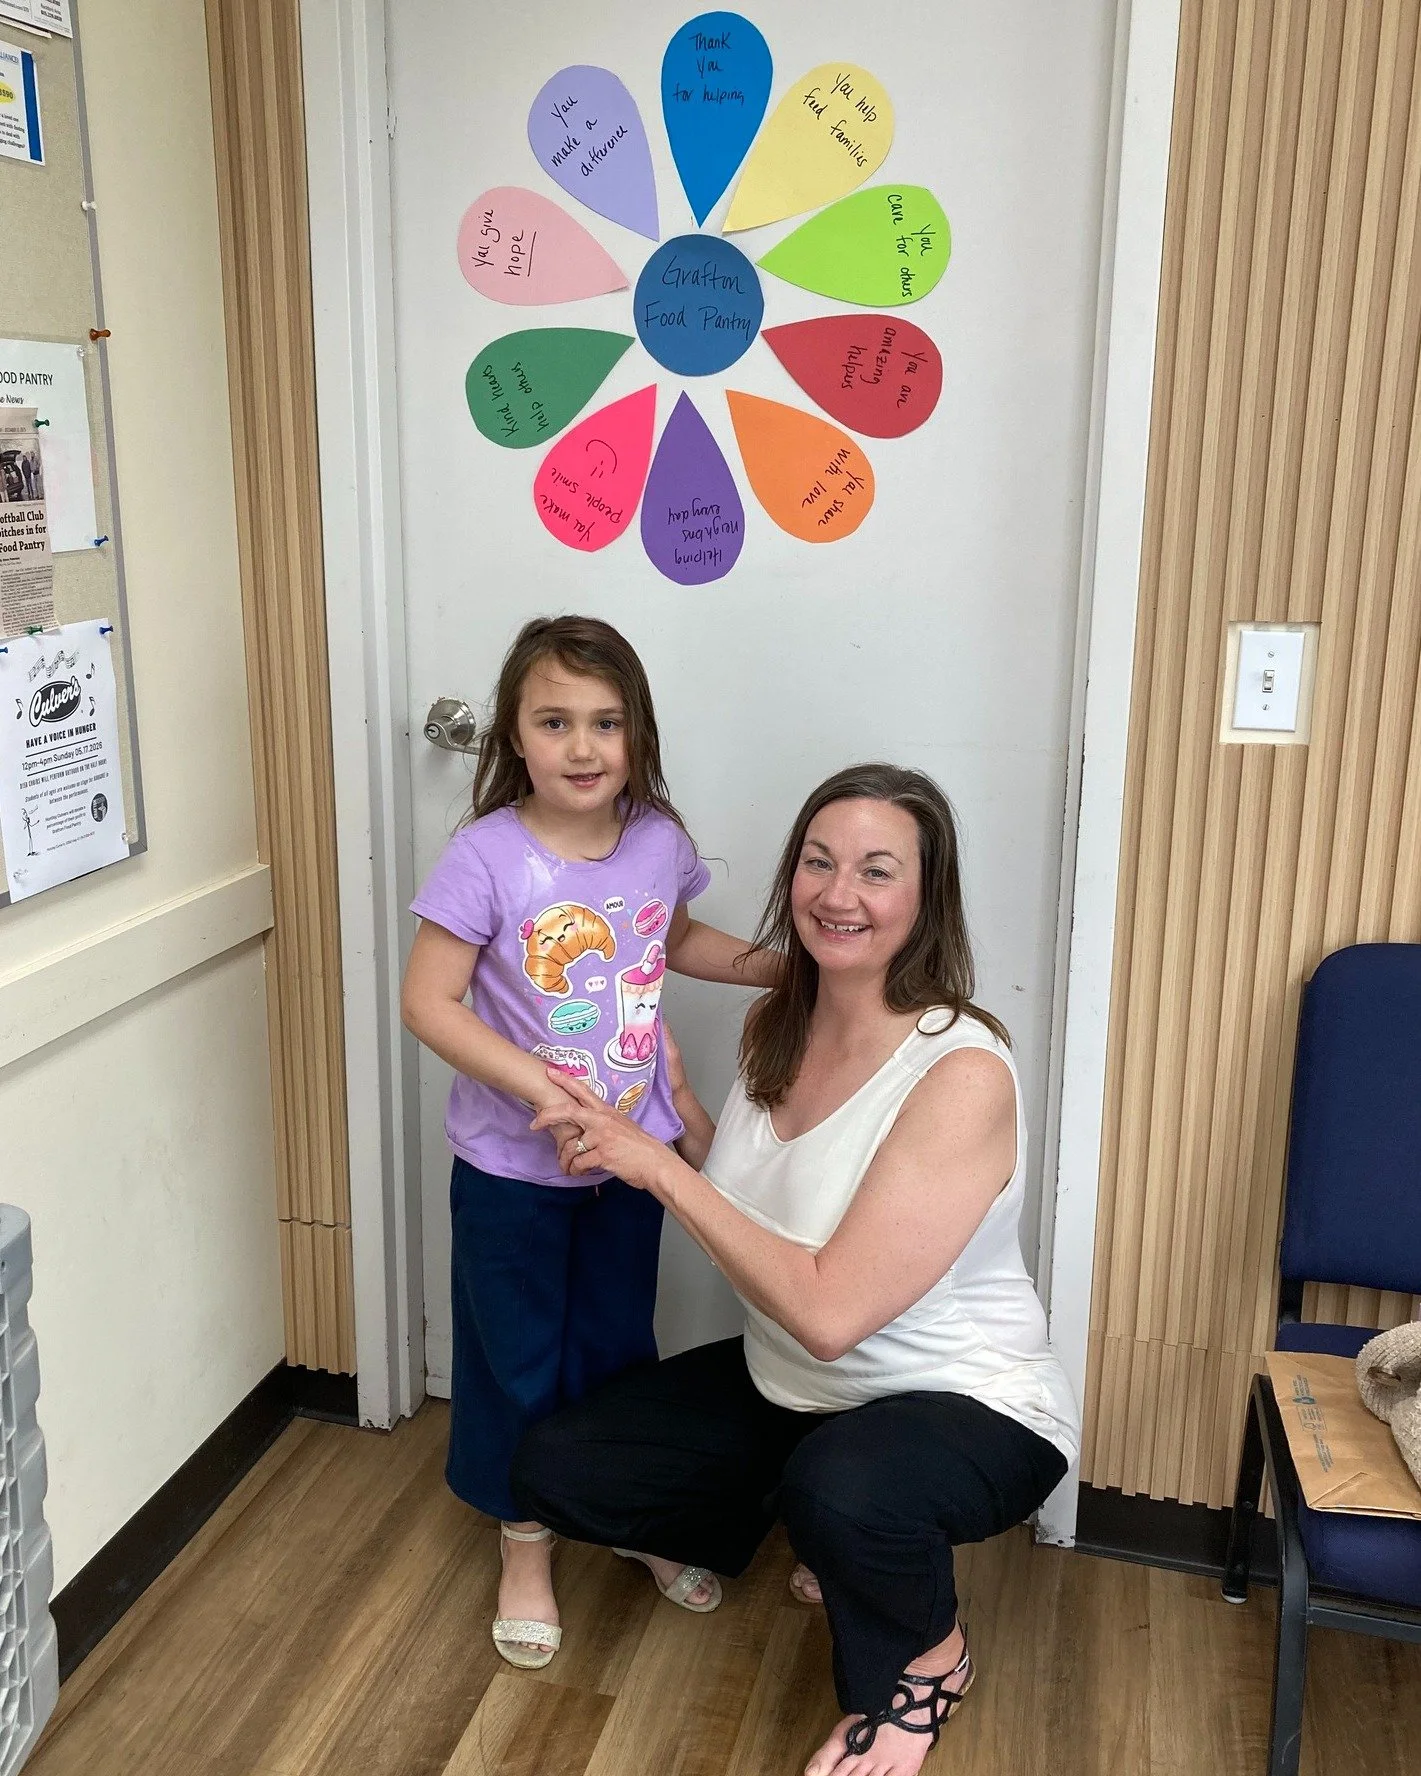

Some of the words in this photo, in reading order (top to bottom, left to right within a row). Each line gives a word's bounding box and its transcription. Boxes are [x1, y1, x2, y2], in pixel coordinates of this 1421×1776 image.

[688, 32, 732, 51] Thank
[672, 82, 694, 103] for
[703, 84, 745, 106] helping
[803, 87, 828, 120] feed
[855, 96, 877, 122] help
[552, 135, 581, 167] make
[585, 119, 598, 131] a
[580, 125, 628, 177] difference
[830, 119, 868, 167] families
[478, 209, 501, 243] give
[503, 229, 526, 276] hope
[896, 235, 914, 257] for
[662, 255, 745, 295] Grafton
[900, 267, 916, 297] others
[644, 300, 687, 328] Food
[697, 305, 752, 341] Pantry
[841, 345, 868, 390] helpers
[859, 327, 897, 385] amazing
[19, 372, 53, 386] PANTRY
[482, 364, 505, 401] hearts
[511, 361, 532, 394] others
[896, 385, 911, 409] are
[496, 402, 520, 438] Kind
[529, 401, 550, 433] help
[824, 448, 851, 475] with
[540, 494, 571, 522] make
[801, 480, 827, 509] love
[27, 510, 44, 521] Club
[817, 499, 844, 527] share
[26, 525, 34, 535] in
[35, 524, 46, 534] for
[19, 541, 45, 552] Pantry
[674, 547, 722, 570] Helping
[29, 675, 81, 727] Culver's
[26, 737, 42, 748] HAVE
[44, 734, 48, 744] A
[49, 730, 66, 742] VOICE
[68, 728, 74, 737] IN
[75, 722, 96, 735] HUNGER
[22, 757, 52, 771] 12pm-4pm
[53, 750, 75, 762] Sunday
[606, 900, 624, 910] AMOUR
